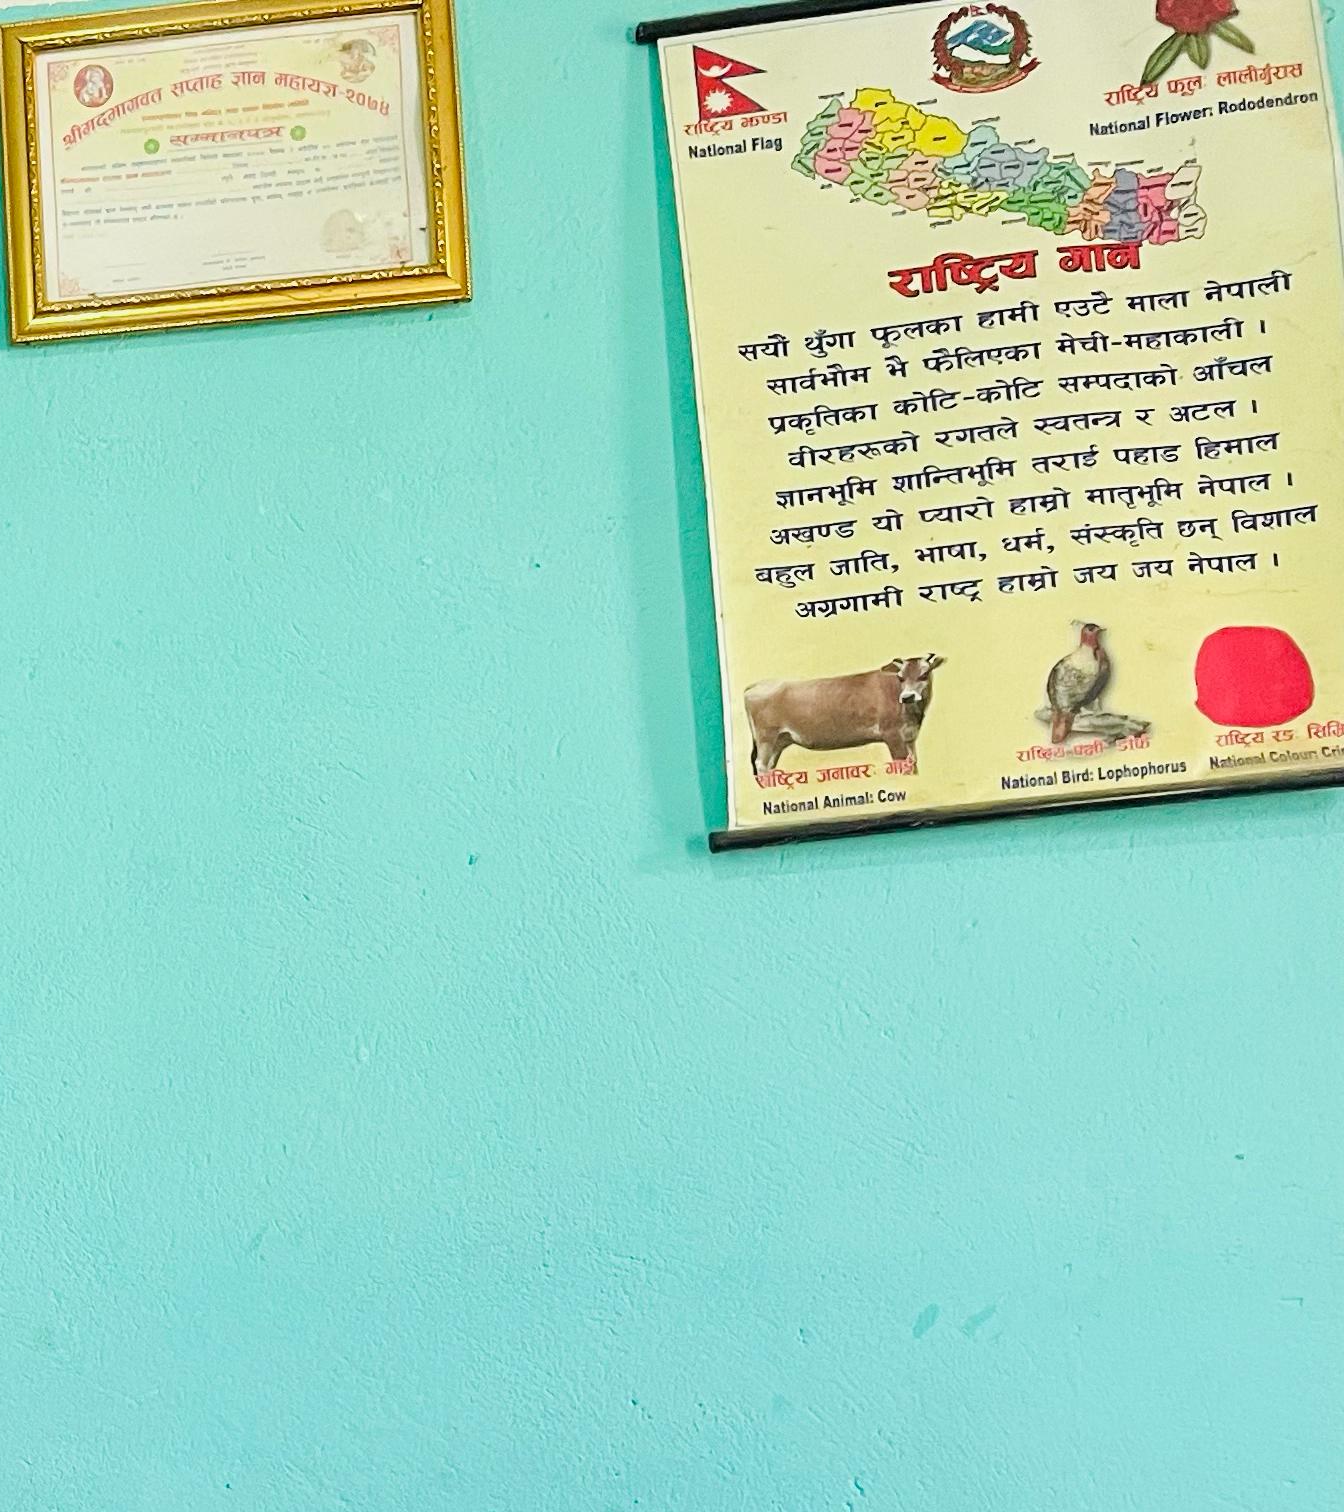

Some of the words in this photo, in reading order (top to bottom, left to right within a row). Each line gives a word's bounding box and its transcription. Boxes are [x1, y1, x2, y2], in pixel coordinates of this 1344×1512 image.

[1089, 115, 1149, 135] National
[1155, 107, 1213, 127] Flower:
[1218, 92, 1317, 114] Rododendron
[688, 139, 746, 158] National
[751, 136, 782, 151] Flag
[888, 250, 1039, 297] राष्ट्रिय
[1057, 242, 1142, 272] गान
[804, 329, 855, 358] थुँगा
[869, 315, 962, 348] फूलका
[976, 300, 1039, 328] हामी
[1053, 290, 1113, 317] एउटै
[1125, 290, 1189, 312] माला
[1203, 269, 1292, 301] नेपाली
[766, 363, 871, 395] सार्वभौम
[884, 355, 908, 377] भै
[921, 341, 1041, 373] फैलिएका
[1055, 316, 1244, 355] मेची-महाकाली
[767, 403, 878, 435] प्रकृतिका
[892, 376, 1043, 415] कोटि-कोटि
[1057, 363, 1177, 393] सम्पदाको
[1192, 355, 1273, 381] आँचल
[787, 430, 919, 467] वीरहरूको
[934, 420, 1018, 447] रगतले
[1033, 410, 1121, 435] स्वतन्त्र
[1134, 408, 1155, 425] र
[1169, 399, 1236, 422] अटल
[775, 475, 877, 509] ज्ञानभूमि
[891, 456, 1017, 493] शान्तिभूमि
[1031, 445, 1099, 473] तराई
[1112, 444, 1181, 465] पहाड
[1194, 432, 1280, 459] हिमाल
[769, 519, 857, 548] अखण्ड
[871, 508, 903, 531] यो
[918, 501, 994, 522] प्यारो
[1008, 487, 1070, 515] हाम्रो
[1084, 477, 1183, 509] मातृभूमि
[1197, 473, 1271, 497] नेपाल
[754, 563, 815, 588] बहुल
[829, 549, 898, 575] जाति,
[914, 541, 986, 563] भाषा,
[1001, 528, 1054, 553] धर्म,
[1069, 516, 1163, 547] संस्कृति
[1176, 518, 1222, 540] छन्
[1231, 504, 1318, 533] विशाल
[795, 585, 903, 617] अग्रगामी
[918, 578, 983, 602] राष्ट्र
[997, 570, 1058, 592] हाम्रो
[1072, 563, 1118, 583] जय
[1131, 559, 1173, 577] जय
[1187, 552, 1257, 574] नेपाल
[1001, 771, 1057, 789] National
[1061, 768, 1093, 783] Bird:
[1097, 761, 1186, 781] Lophophorus
[1209, 752, 1266, 769] National
[1321, 745, 1344, 758] Cri
[763, 796, 818, 815] National
[823, 791, 873, 808] Animal:
[877, 789, 905, 802] Cow
